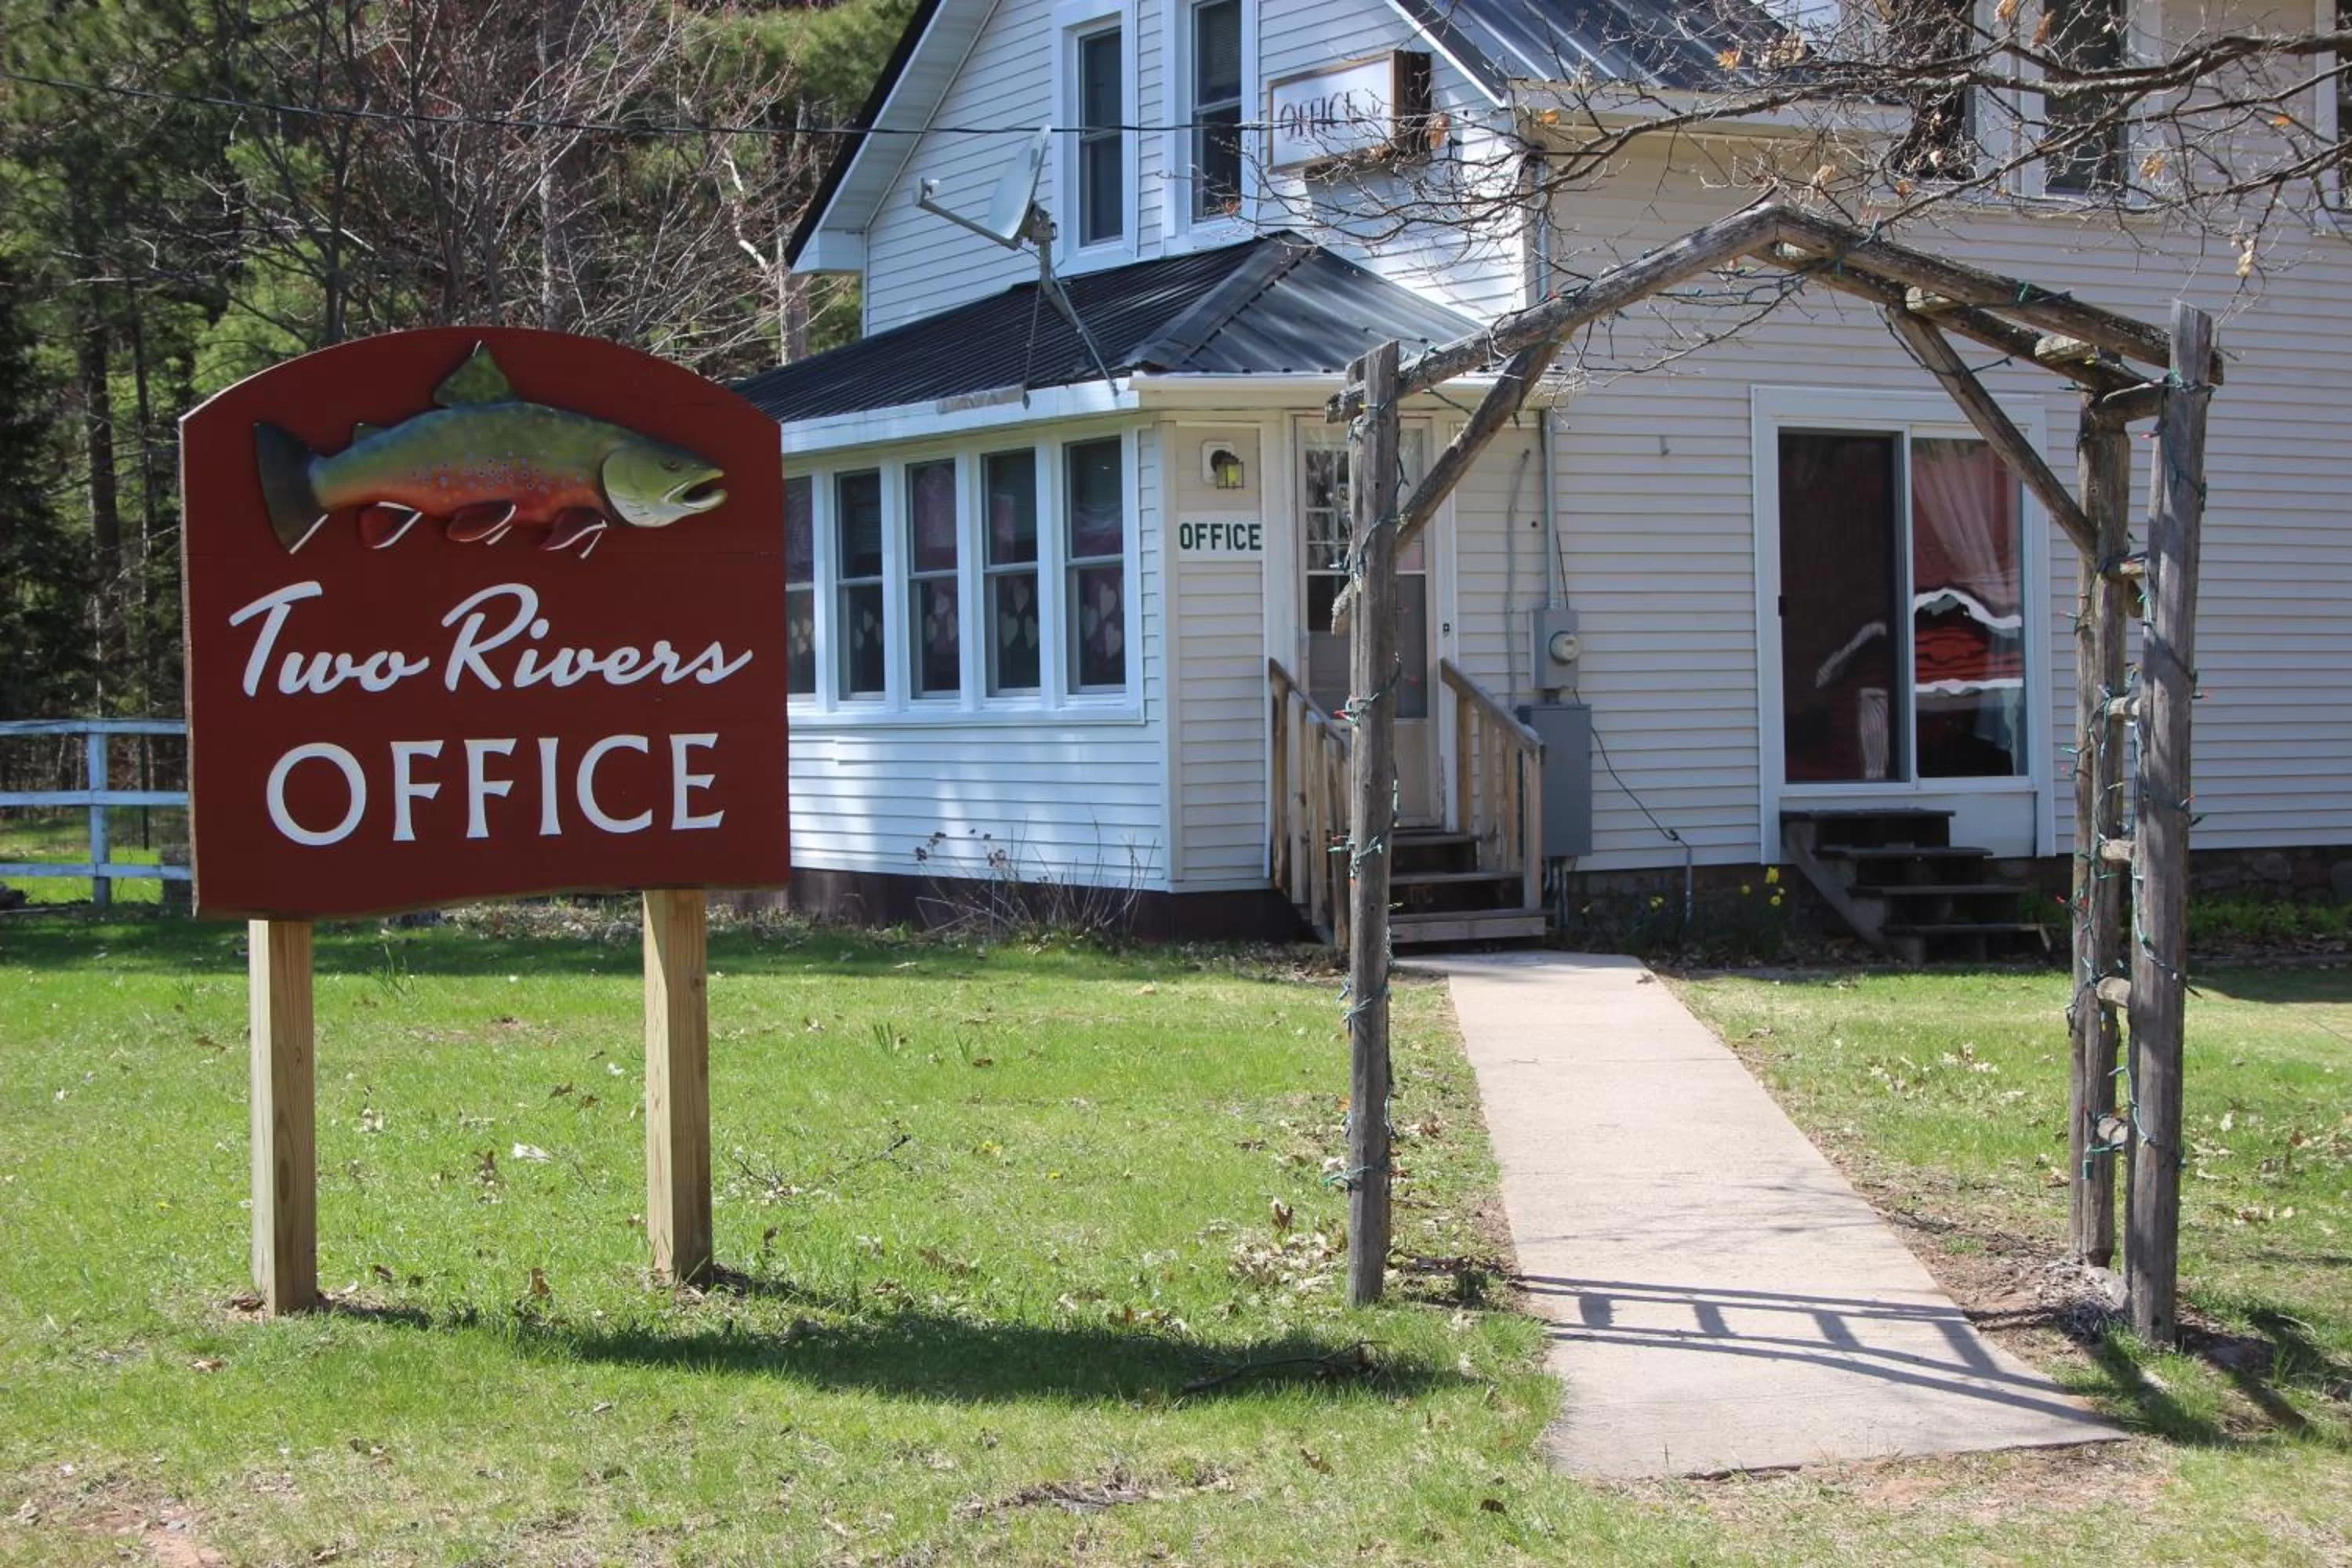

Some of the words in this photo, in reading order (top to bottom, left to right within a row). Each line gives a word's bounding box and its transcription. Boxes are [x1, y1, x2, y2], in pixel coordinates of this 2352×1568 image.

[1178, 522, 1263, 551] OFFICE
[228, 580, 430, 698] Two
[441, 582, 754, 692] Rivers
[265, 732, 726, 847] OFFICE
